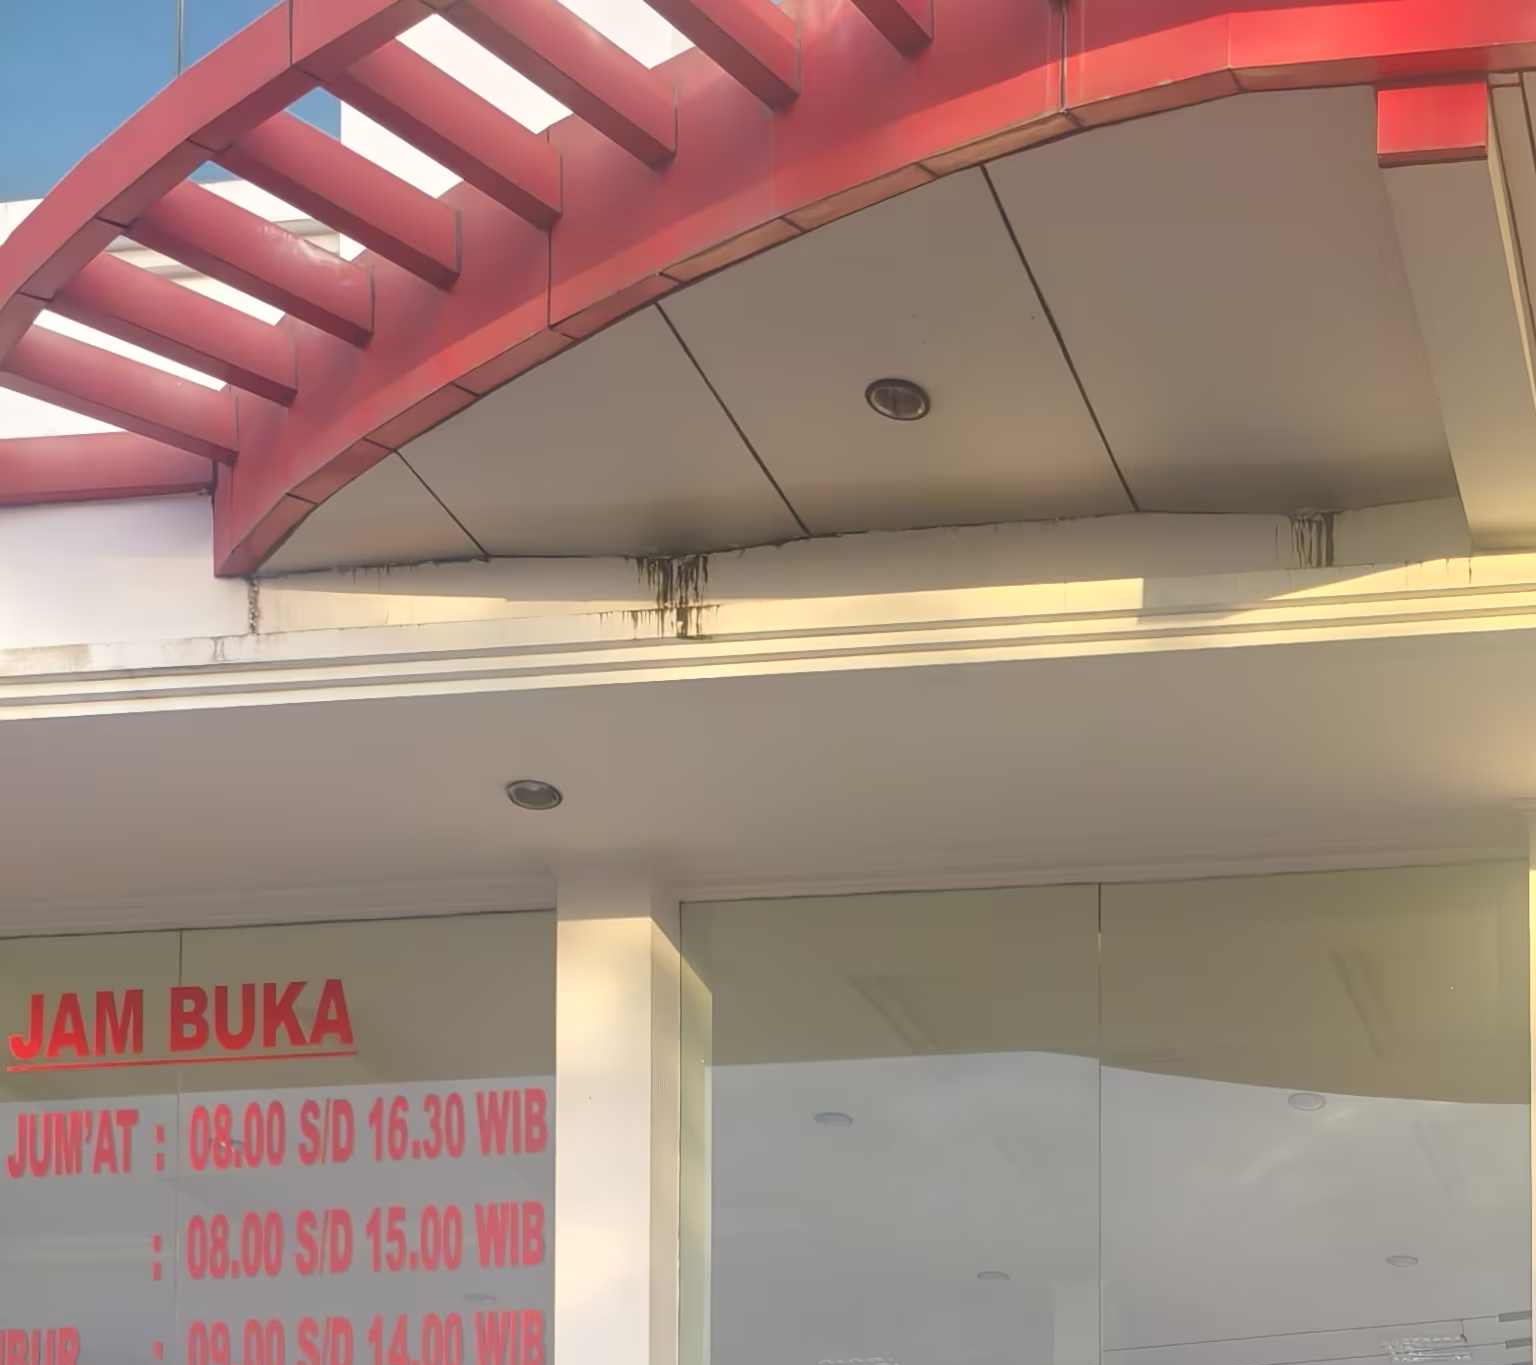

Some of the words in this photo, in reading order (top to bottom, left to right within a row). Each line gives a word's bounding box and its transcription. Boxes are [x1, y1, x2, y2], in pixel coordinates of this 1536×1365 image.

[8, 988, 145, 1060] JAM
[168, 978, 356, 1053] BUKA
[5, 1108, 139, 1179] JUM'AT
[187, 1100, 287, 1172] 08.00
[297, 1098, 355, 1167] S/D
[367, 1092, 465, 1161] 16.30
[475, 1088, 549, 1155] WIB
[185, 1210, 284, 1280] 08.00
[293, 1207, 354, 1277] S/D
[364, 1204, 463, 1273] 15.00
[473, 1200, 546, 1269] WIB
